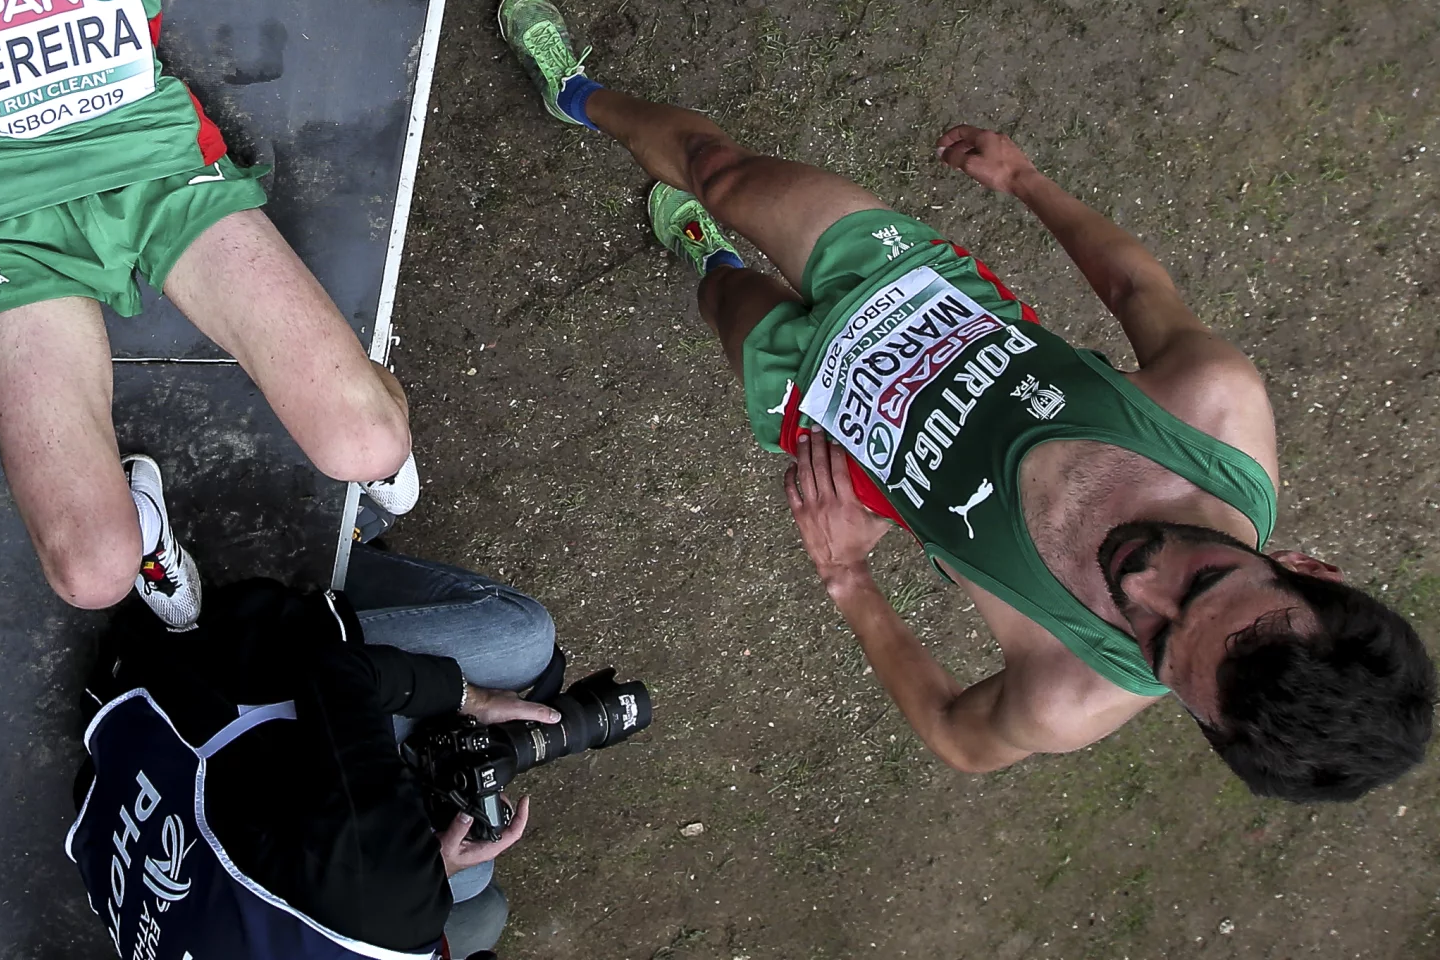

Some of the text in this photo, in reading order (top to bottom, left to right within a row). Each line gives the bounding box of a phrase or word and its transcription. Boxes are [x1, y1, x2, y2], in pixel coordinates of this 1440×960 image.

[4, 89, 43, 114] RUN
[77, 88, 124, 114] 2019
[872, 225, 899, 239] FPA
[905, 303, 915, 311] I
[821, 287, 905, 388] LISBOA 2019
[872, 309, 908, 339] RUN
[839, 295, 975, 445] MARQUES
[881, 318, 996, 419] SPAR
[1010, 373, 1036, 398] FPA
[887, 325, 1038, 509] PORTUGAL
